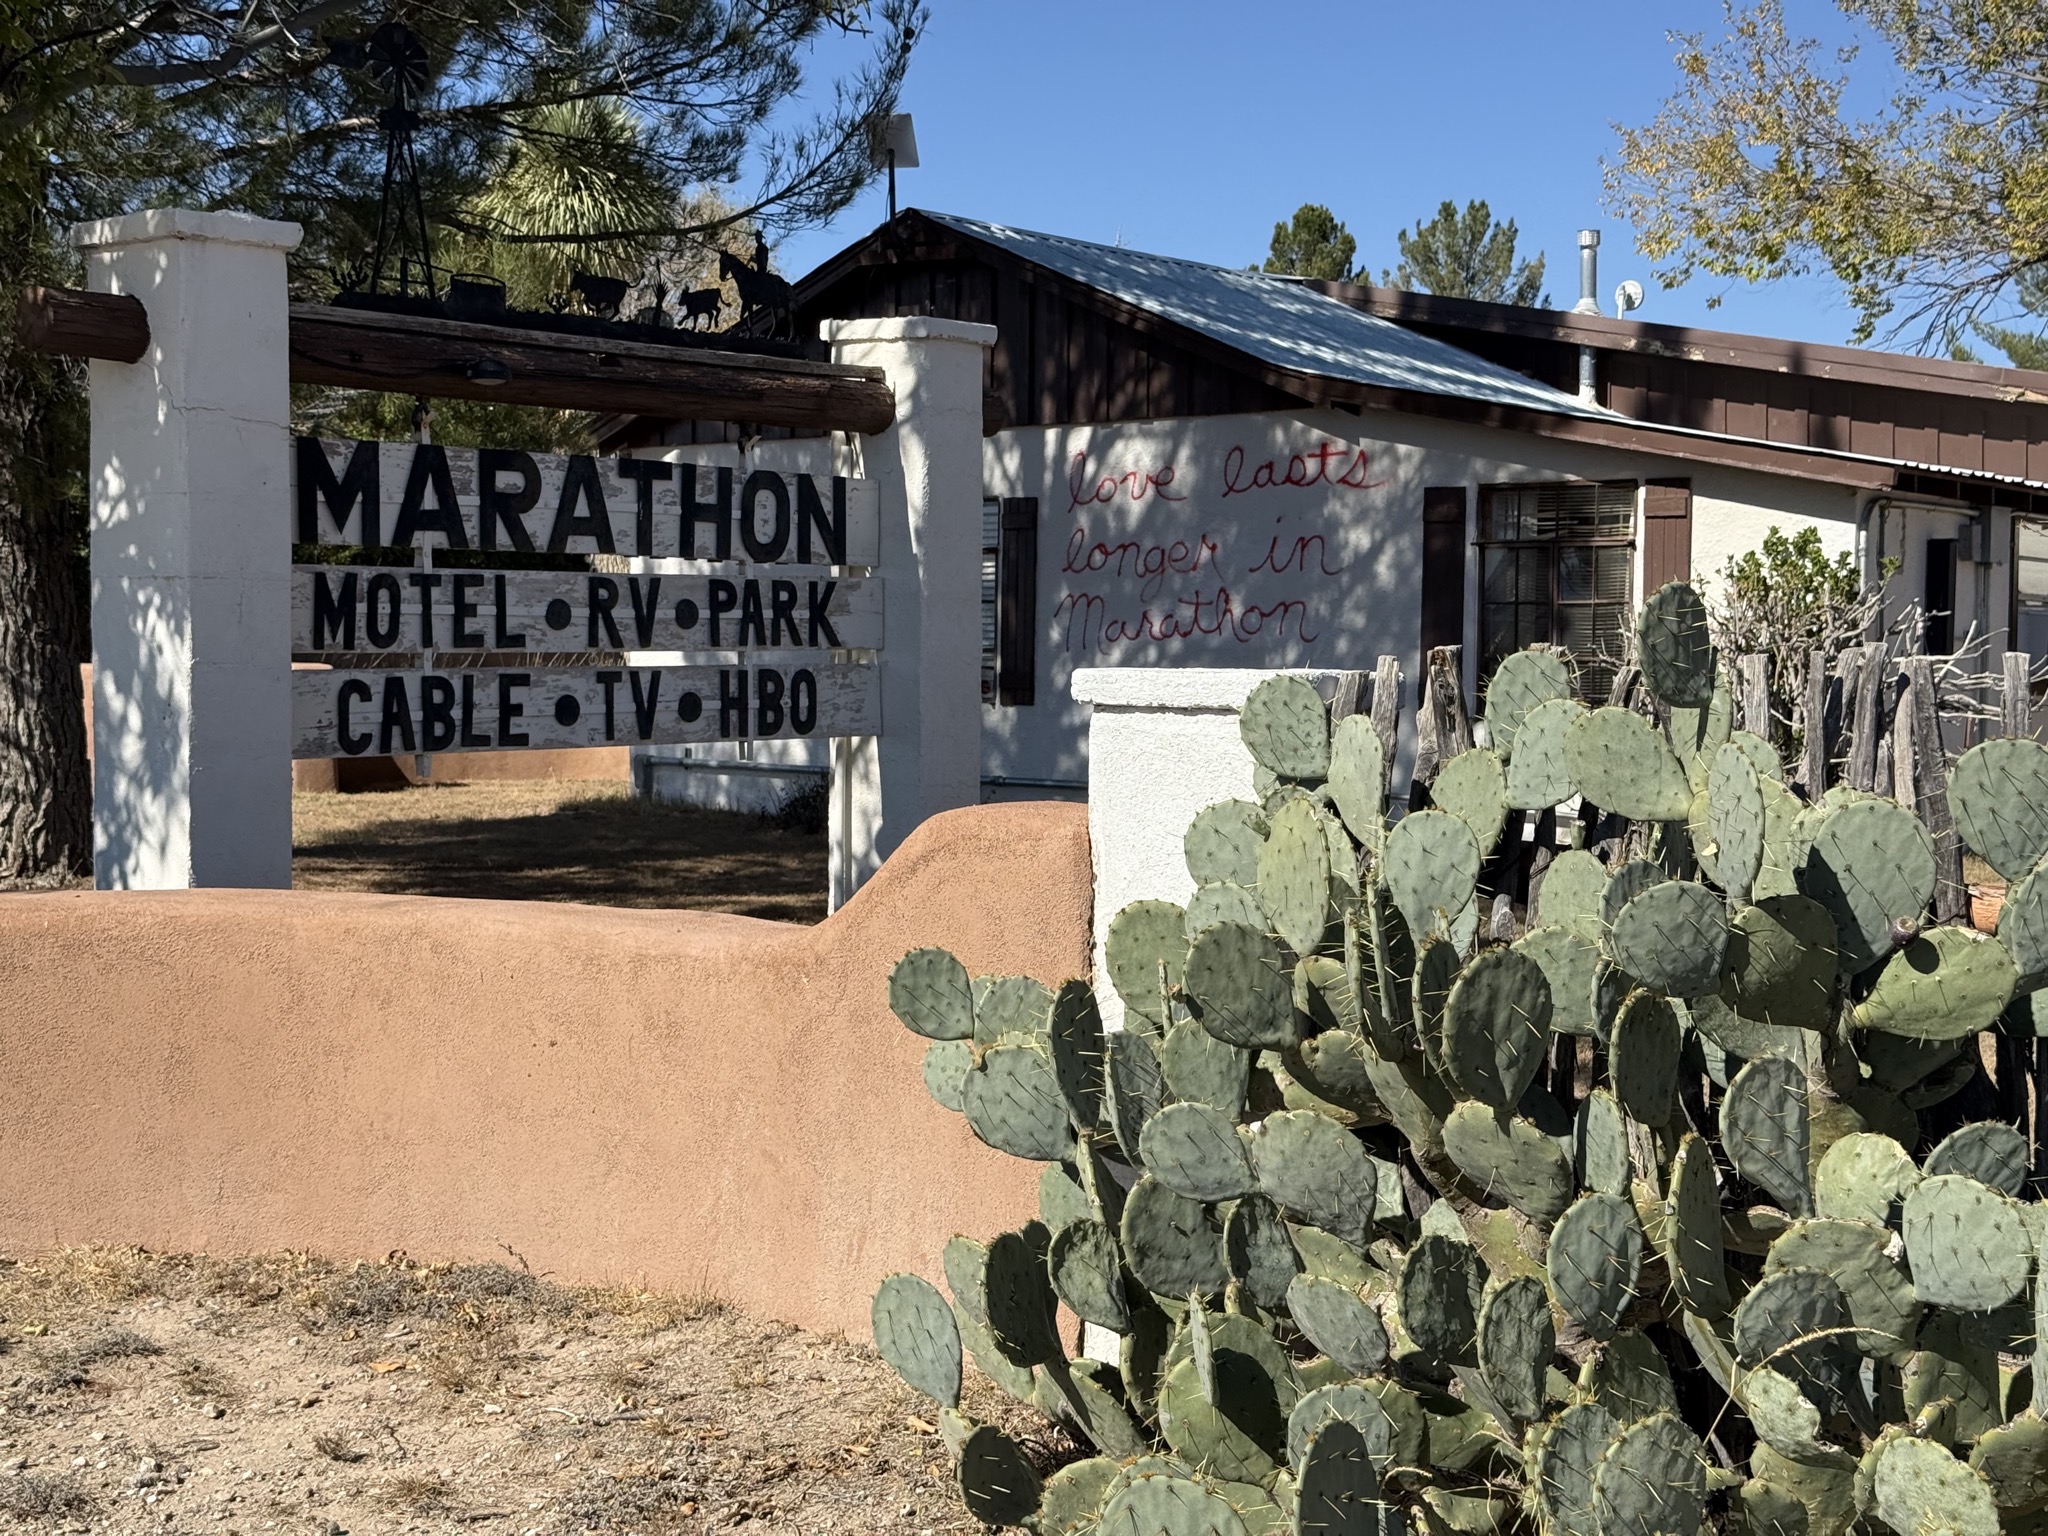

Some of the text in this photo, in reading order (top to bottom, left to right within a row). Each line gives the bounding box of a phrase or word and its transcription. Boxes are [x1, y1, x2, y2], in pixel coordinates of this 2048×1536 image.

[296, 436, 847, 566] MARATHON
[1068, 442, 1390, 513] love lasts
[1062, 515, 1344, 601] longer in
[312, 571, 842, 651] MOTEL RV PARK
[1053, 585, 1320, 656] Marathon
[337, 668, 818, 755] CABLE TV HBO
